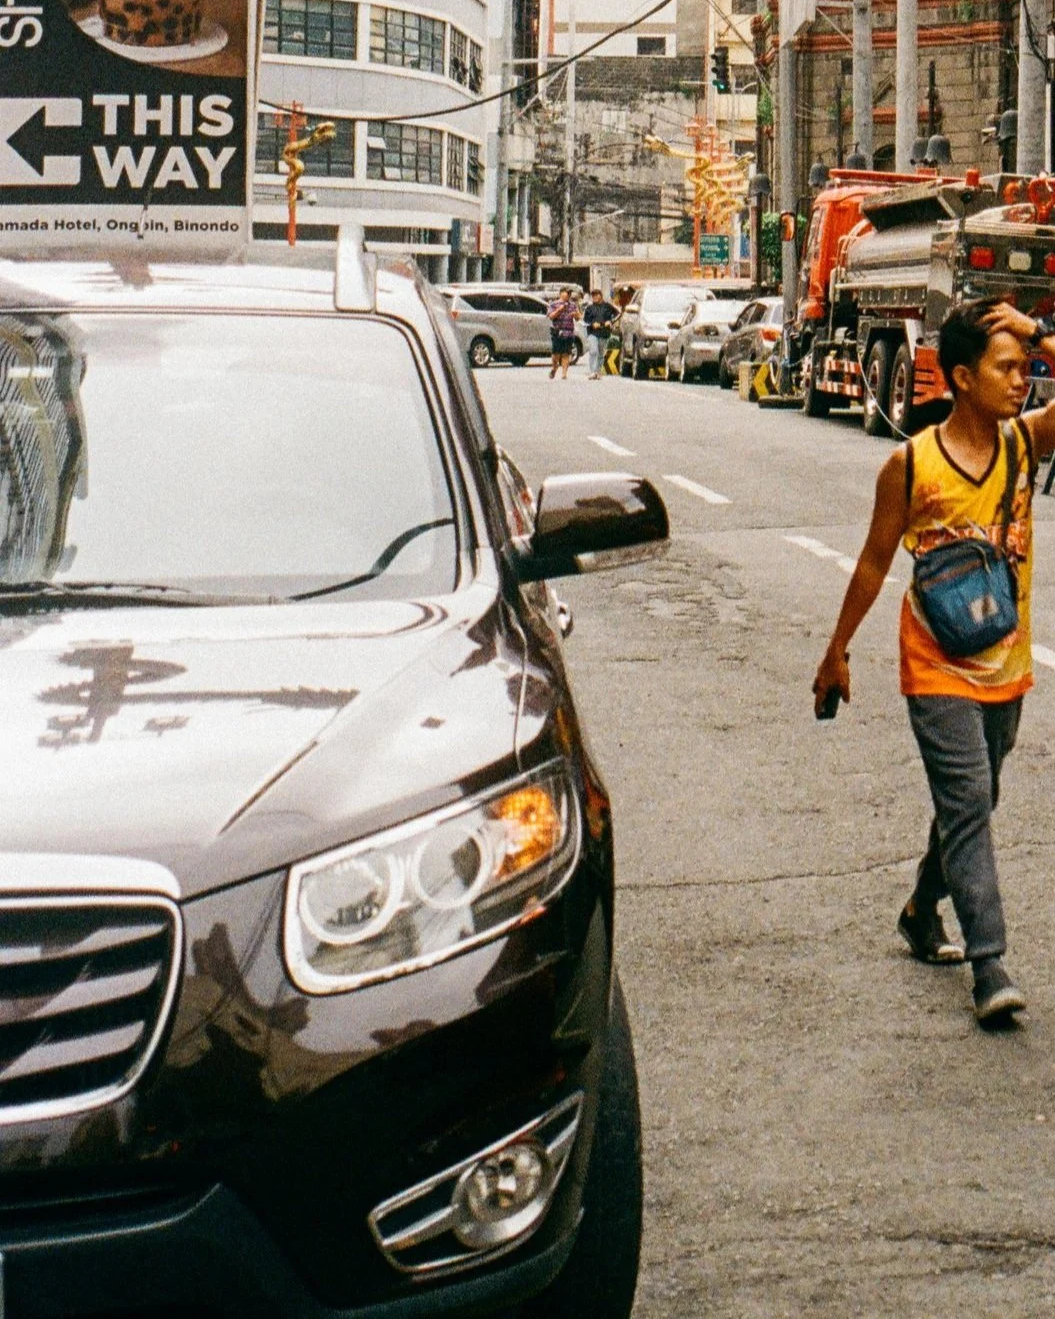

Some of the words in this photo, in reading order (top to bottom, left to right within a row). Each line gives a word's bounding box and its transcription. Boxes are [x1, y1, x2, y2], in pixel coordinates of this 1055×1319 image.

[92, 94, 234, 137] THIS
[92, 146, 237, 189] WAY
[54, 218, 101, 233] Hotel,
[174, 220, 239, 232] Binondo
